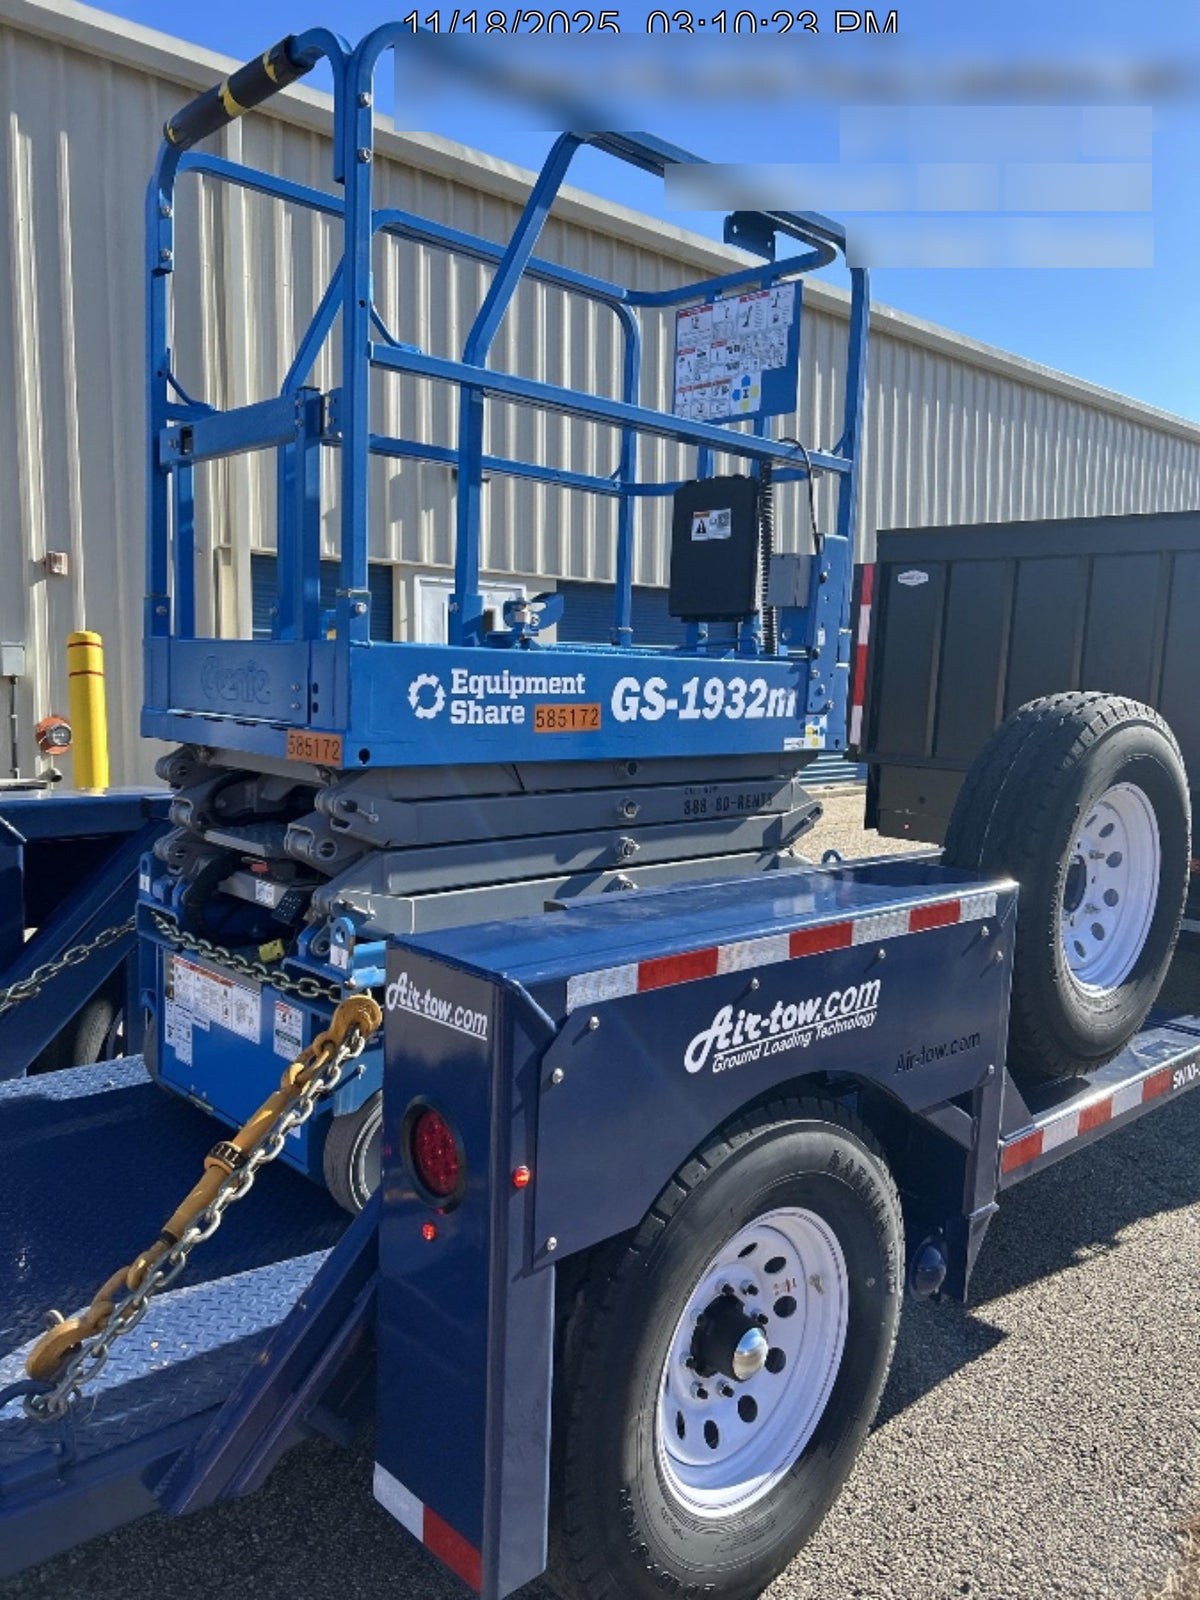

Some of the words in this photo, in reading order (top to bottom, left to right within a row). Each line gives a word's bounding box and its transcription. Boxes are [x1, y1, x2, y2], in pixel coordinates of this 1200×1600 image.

[451, 668, 586, 699] Equipment
[611, 676, 796, 722] GS-1932m
[450, 700, 525, 724] Share
[536, 708, 600, 728] 585172
[288, 735, 340, 761] 585172
[385, 971, 488, 1036] Air-tow.com
[684, 979, 881, 1074] Air-tow.com
[712, 1046, 762, 1074] Ground
[762, 1031, 813, 1058] Loading
[815, 1010, 878, 1042] Technology
[894, 1032, 980, 1073] Air-tow.com
